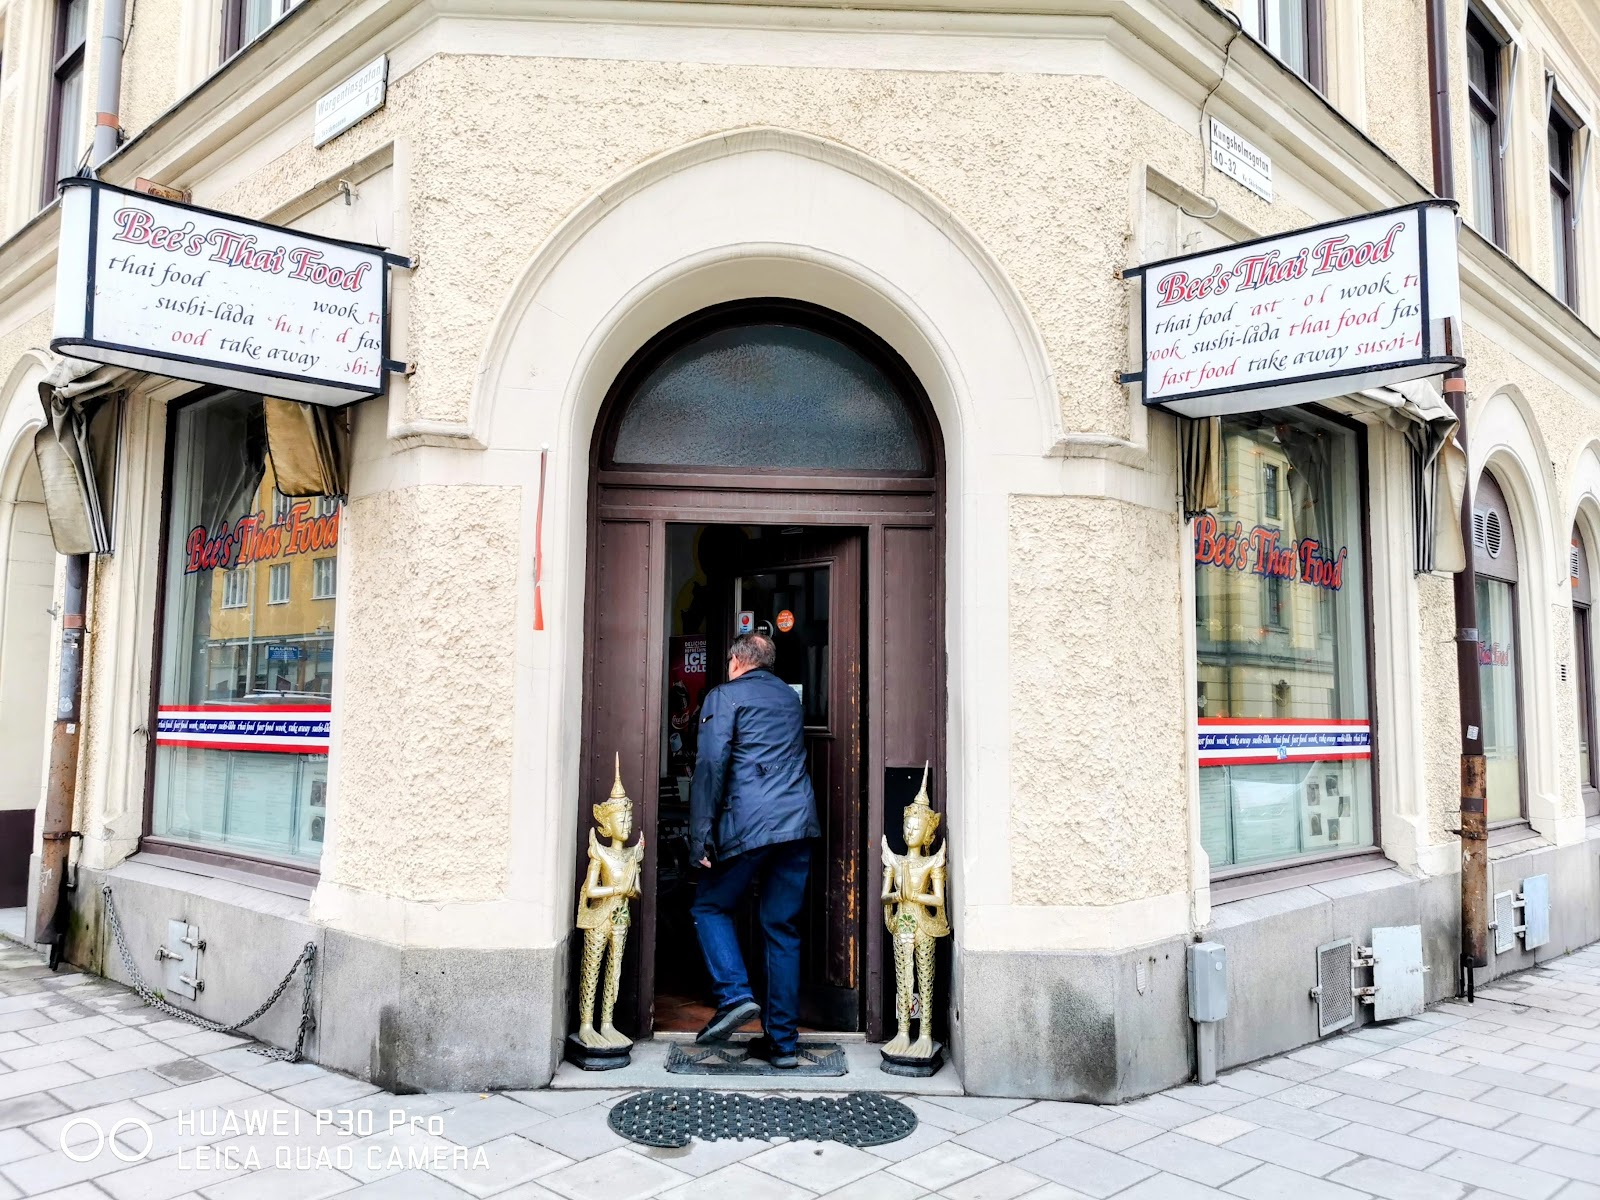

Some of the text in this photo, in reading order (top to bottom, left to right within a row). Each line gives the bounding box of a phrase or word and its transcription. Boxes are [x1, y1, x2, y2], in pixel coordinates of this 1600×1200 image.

[1213, 123, 1269, 173] Kungsholmsgatan
[1214, 150, 1237, 175] 40-32
[112, 207, 372, 292] Bee's Thai Food
[1156, 222, 1406, 308] Bee's Thai Food
[108, 254, 156, 278] thai
[150, 263, 211, 287] food
[313, 301, 365, 325] wook
[155, 296, 255, 326] sushi-låda
[1155, 313, 1192, 335] thai
[1187, 301, 1239, 337] food
[1340, 272, 1399, 301] wook
[171, 329, 212, 346] ood
[219, 336, 262, 360] take
[267, 348, 320, 372] away
[1191, 323, 1280, 354] sushi-låda
[1288, 314, 1330, 337] thai
[1326, 301, 1386, 338] food
[1152, 367, 1198, 395] fast
[1190, 356, 1242, 389] food
[1248, 349, 1289, 373] take
[1293, 345, 1349, 368] away
[184, 499, 340, 576] Bee's Thai Food
[1194, 511, 1348, 591] Bee's Thai Food
[684, 652, 707, 665] ICE
